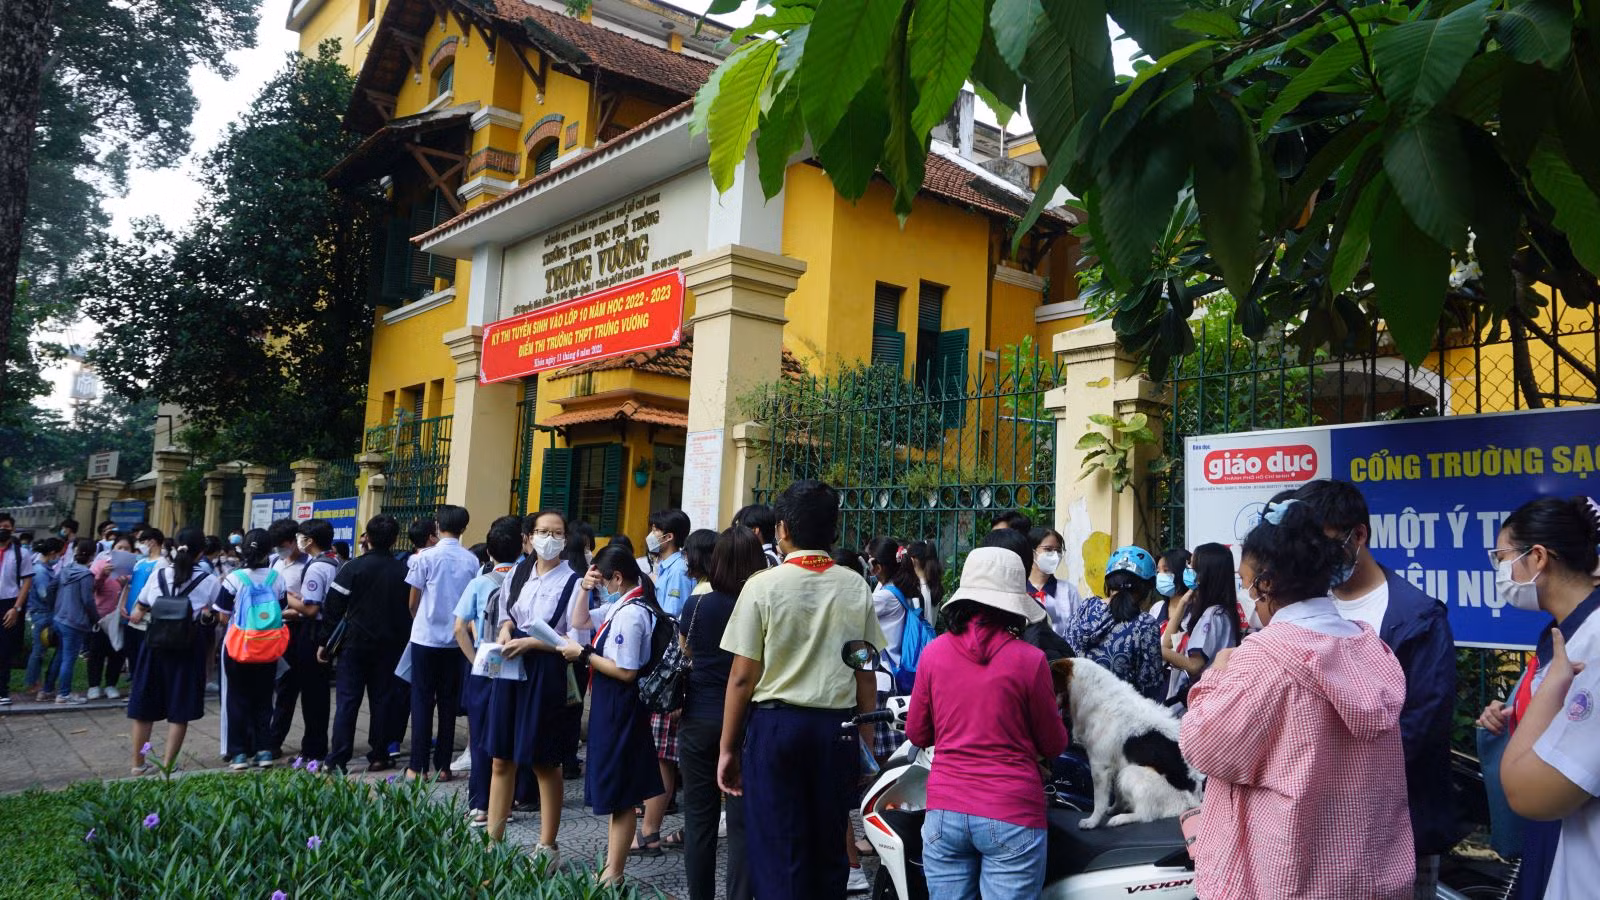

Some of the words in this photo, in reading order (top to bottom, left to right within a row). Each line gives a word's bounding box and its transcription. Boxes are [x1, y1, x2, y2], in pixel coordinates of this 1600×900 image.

[594, 229, 610, 248] HỌC
[612, 214, 629, 240] PHỔ
[631, 210, 659, 233] THÔNG
[597, 234, 650, 276] VƯƠNG
[501, 329, 511, 343] THI
[512, 318, 532, 340] TUYỂN
[532, 319, 548, 335] SINH
[549, 312, 563, 330] VÀO
[564, 308, 578, 326] LỚP
[579, 307, 588, 322] 10
[588, 301, 606, 319] NĂM
[607, 296, 624, 317] HỌC
[624, 291, 645, 310] 2022
[650, 284, 672, 304] 2023
[535, 338, 546, 353] THI
[546, 331, 574, 351] TRƯỜNG
[574, 326, 593, 344] THPT
[594, 319, 620, 339] TRƯNG
[621, 312, 650, 333] VƯƠNG
[1208, 452, 1262, 480] giáo
[1266, 451, 1313, 477] dục
[1350, 449, 1421, 483] CỔNG
[1427, 445, 1544, 479] TRƯỜNG
[1369, 506, 1440, 558] MỘT
[1446, 504, 1469, 549] Ý
[1125, 878, 1194, 894] VISION
